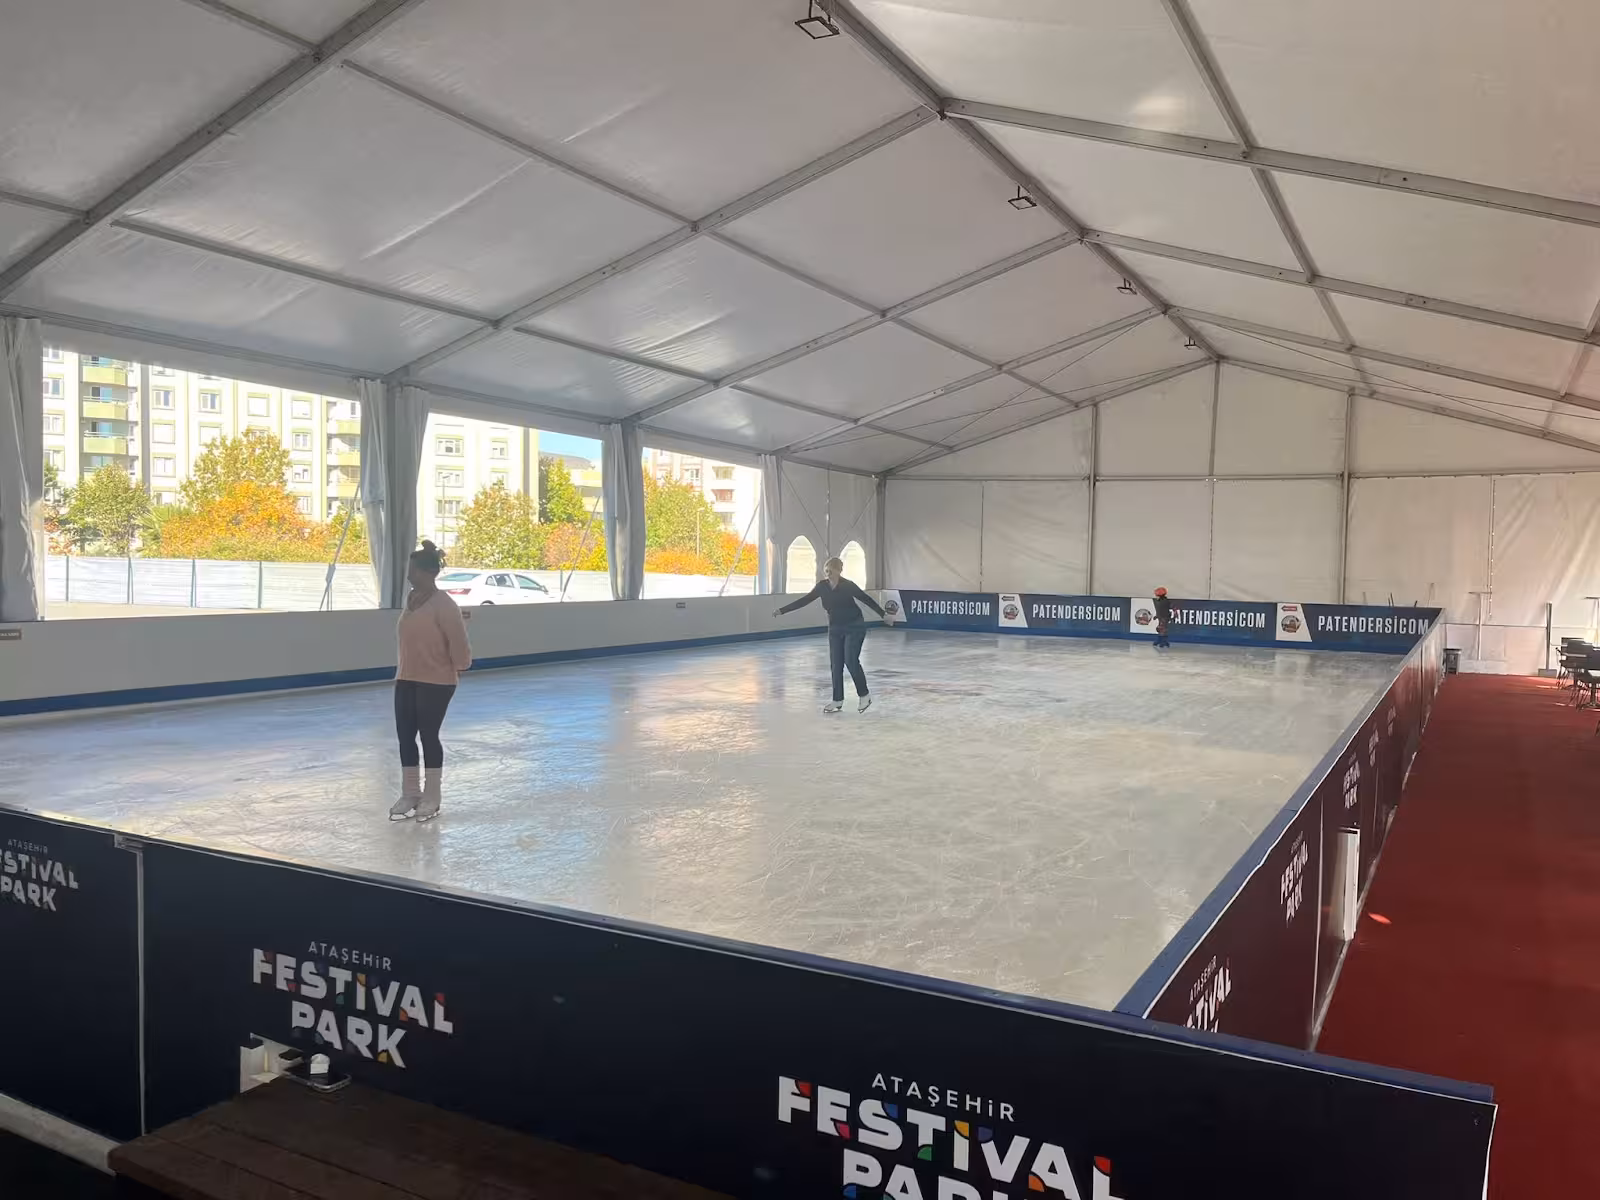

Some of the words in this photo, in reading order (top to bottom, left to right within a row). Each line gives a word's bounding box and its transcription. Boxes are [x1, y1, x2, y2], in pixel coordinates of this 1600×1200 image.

[0, 848, 79, 890] STIVAL
[0, 875, 57, 912] PARK
[253, 947, 454, 1035] FESTIVAL
[291, 1000, 407, 1069] PARK
[778, 1075, 1126, 1200] FESTIVAL
